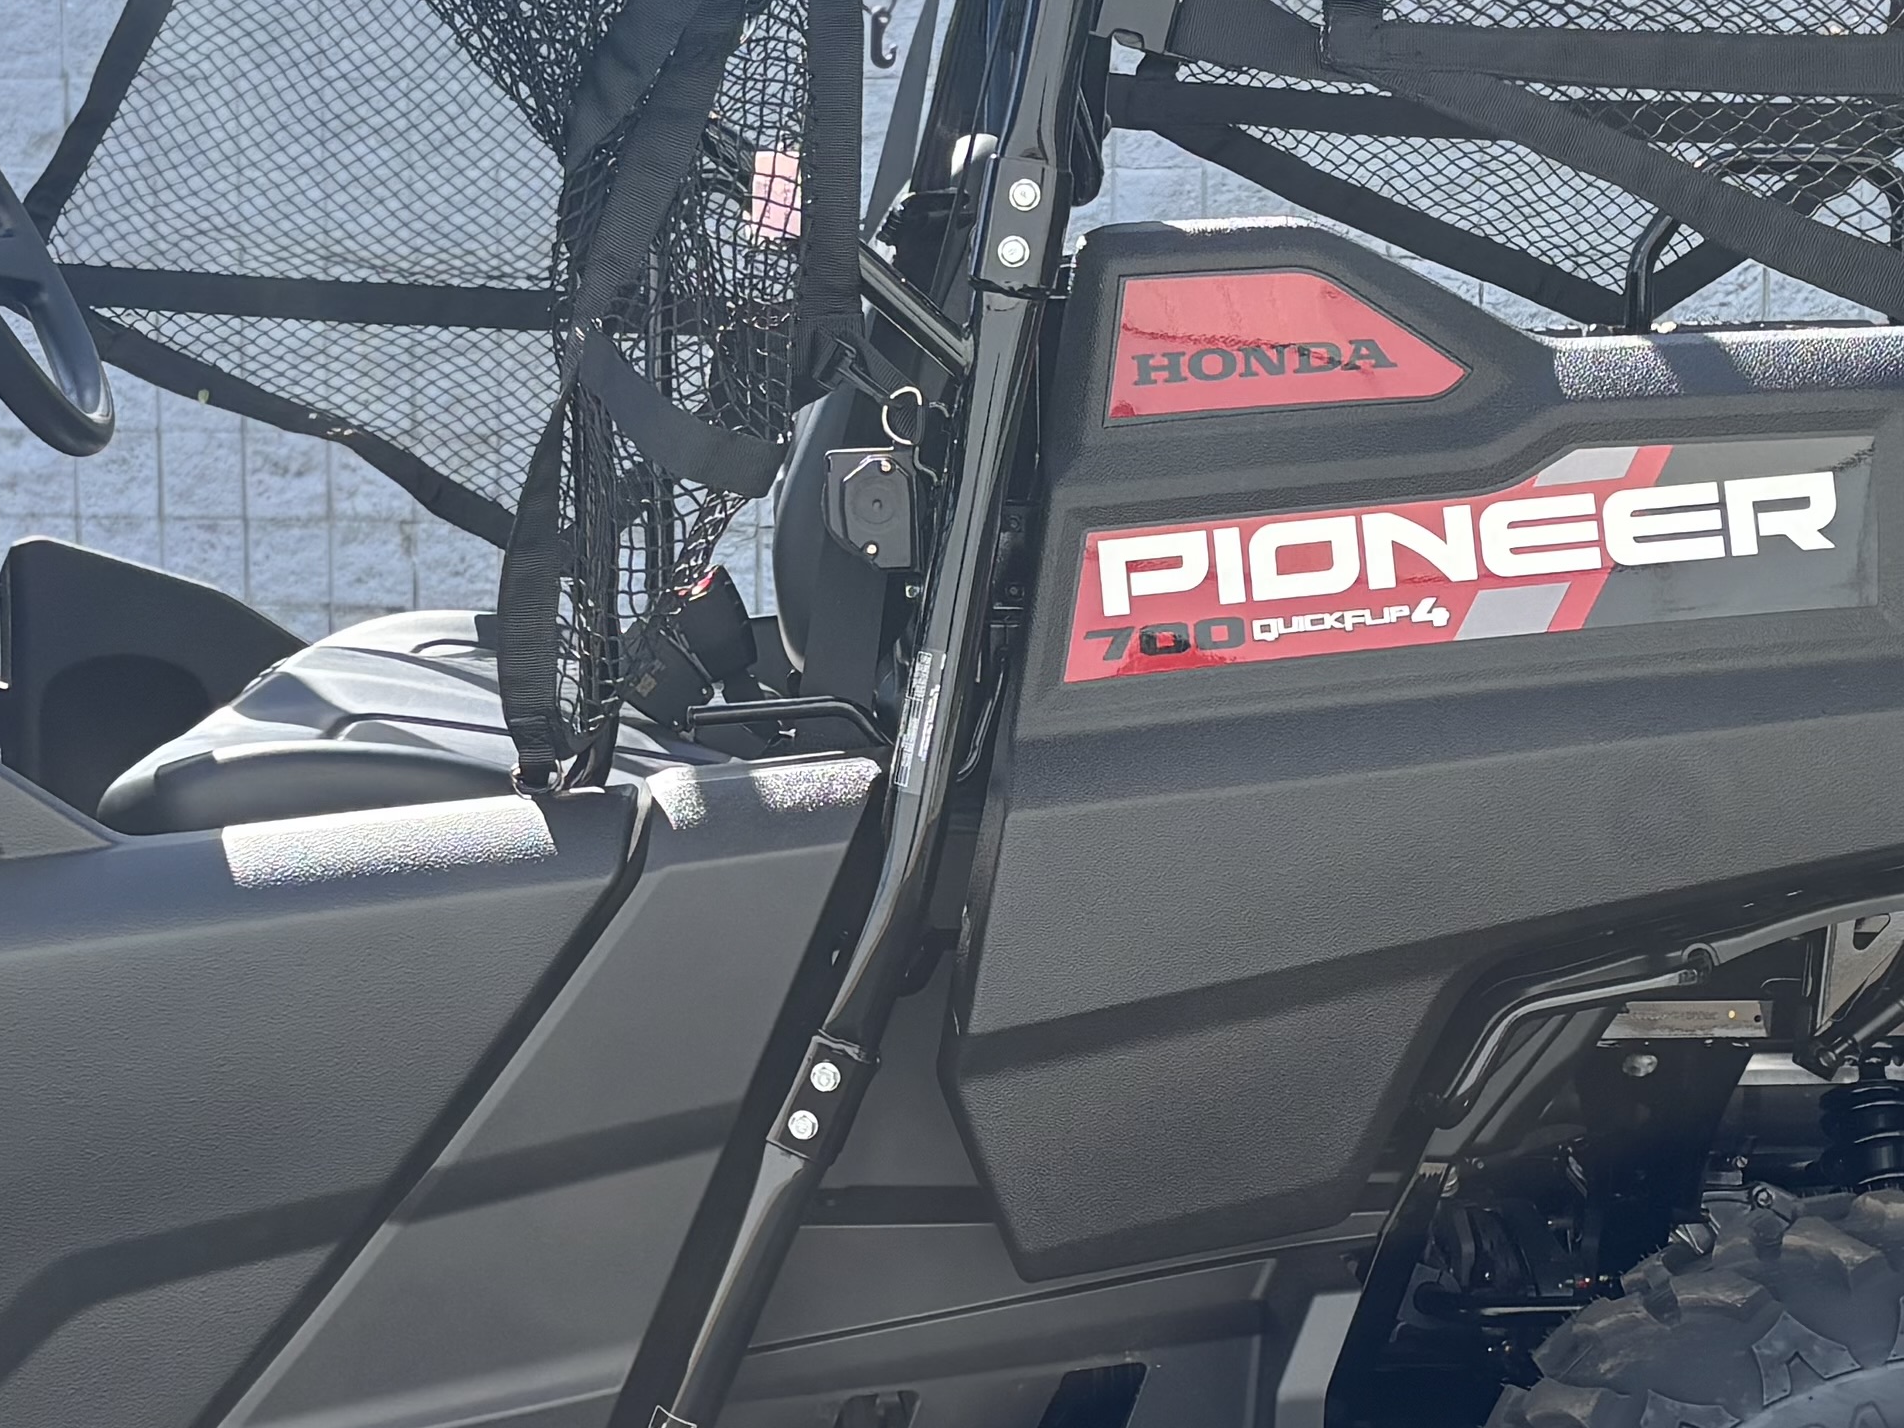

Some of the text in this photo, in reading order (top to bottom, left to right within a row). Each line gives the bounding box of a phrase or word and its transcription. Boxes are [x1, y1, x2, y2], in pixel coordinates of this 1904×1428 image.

[1130, 338, 1399, 387] HONDA
[1097, 470, 1838, 618] PIONEER
[1083, 616, 1246, 662] 700
